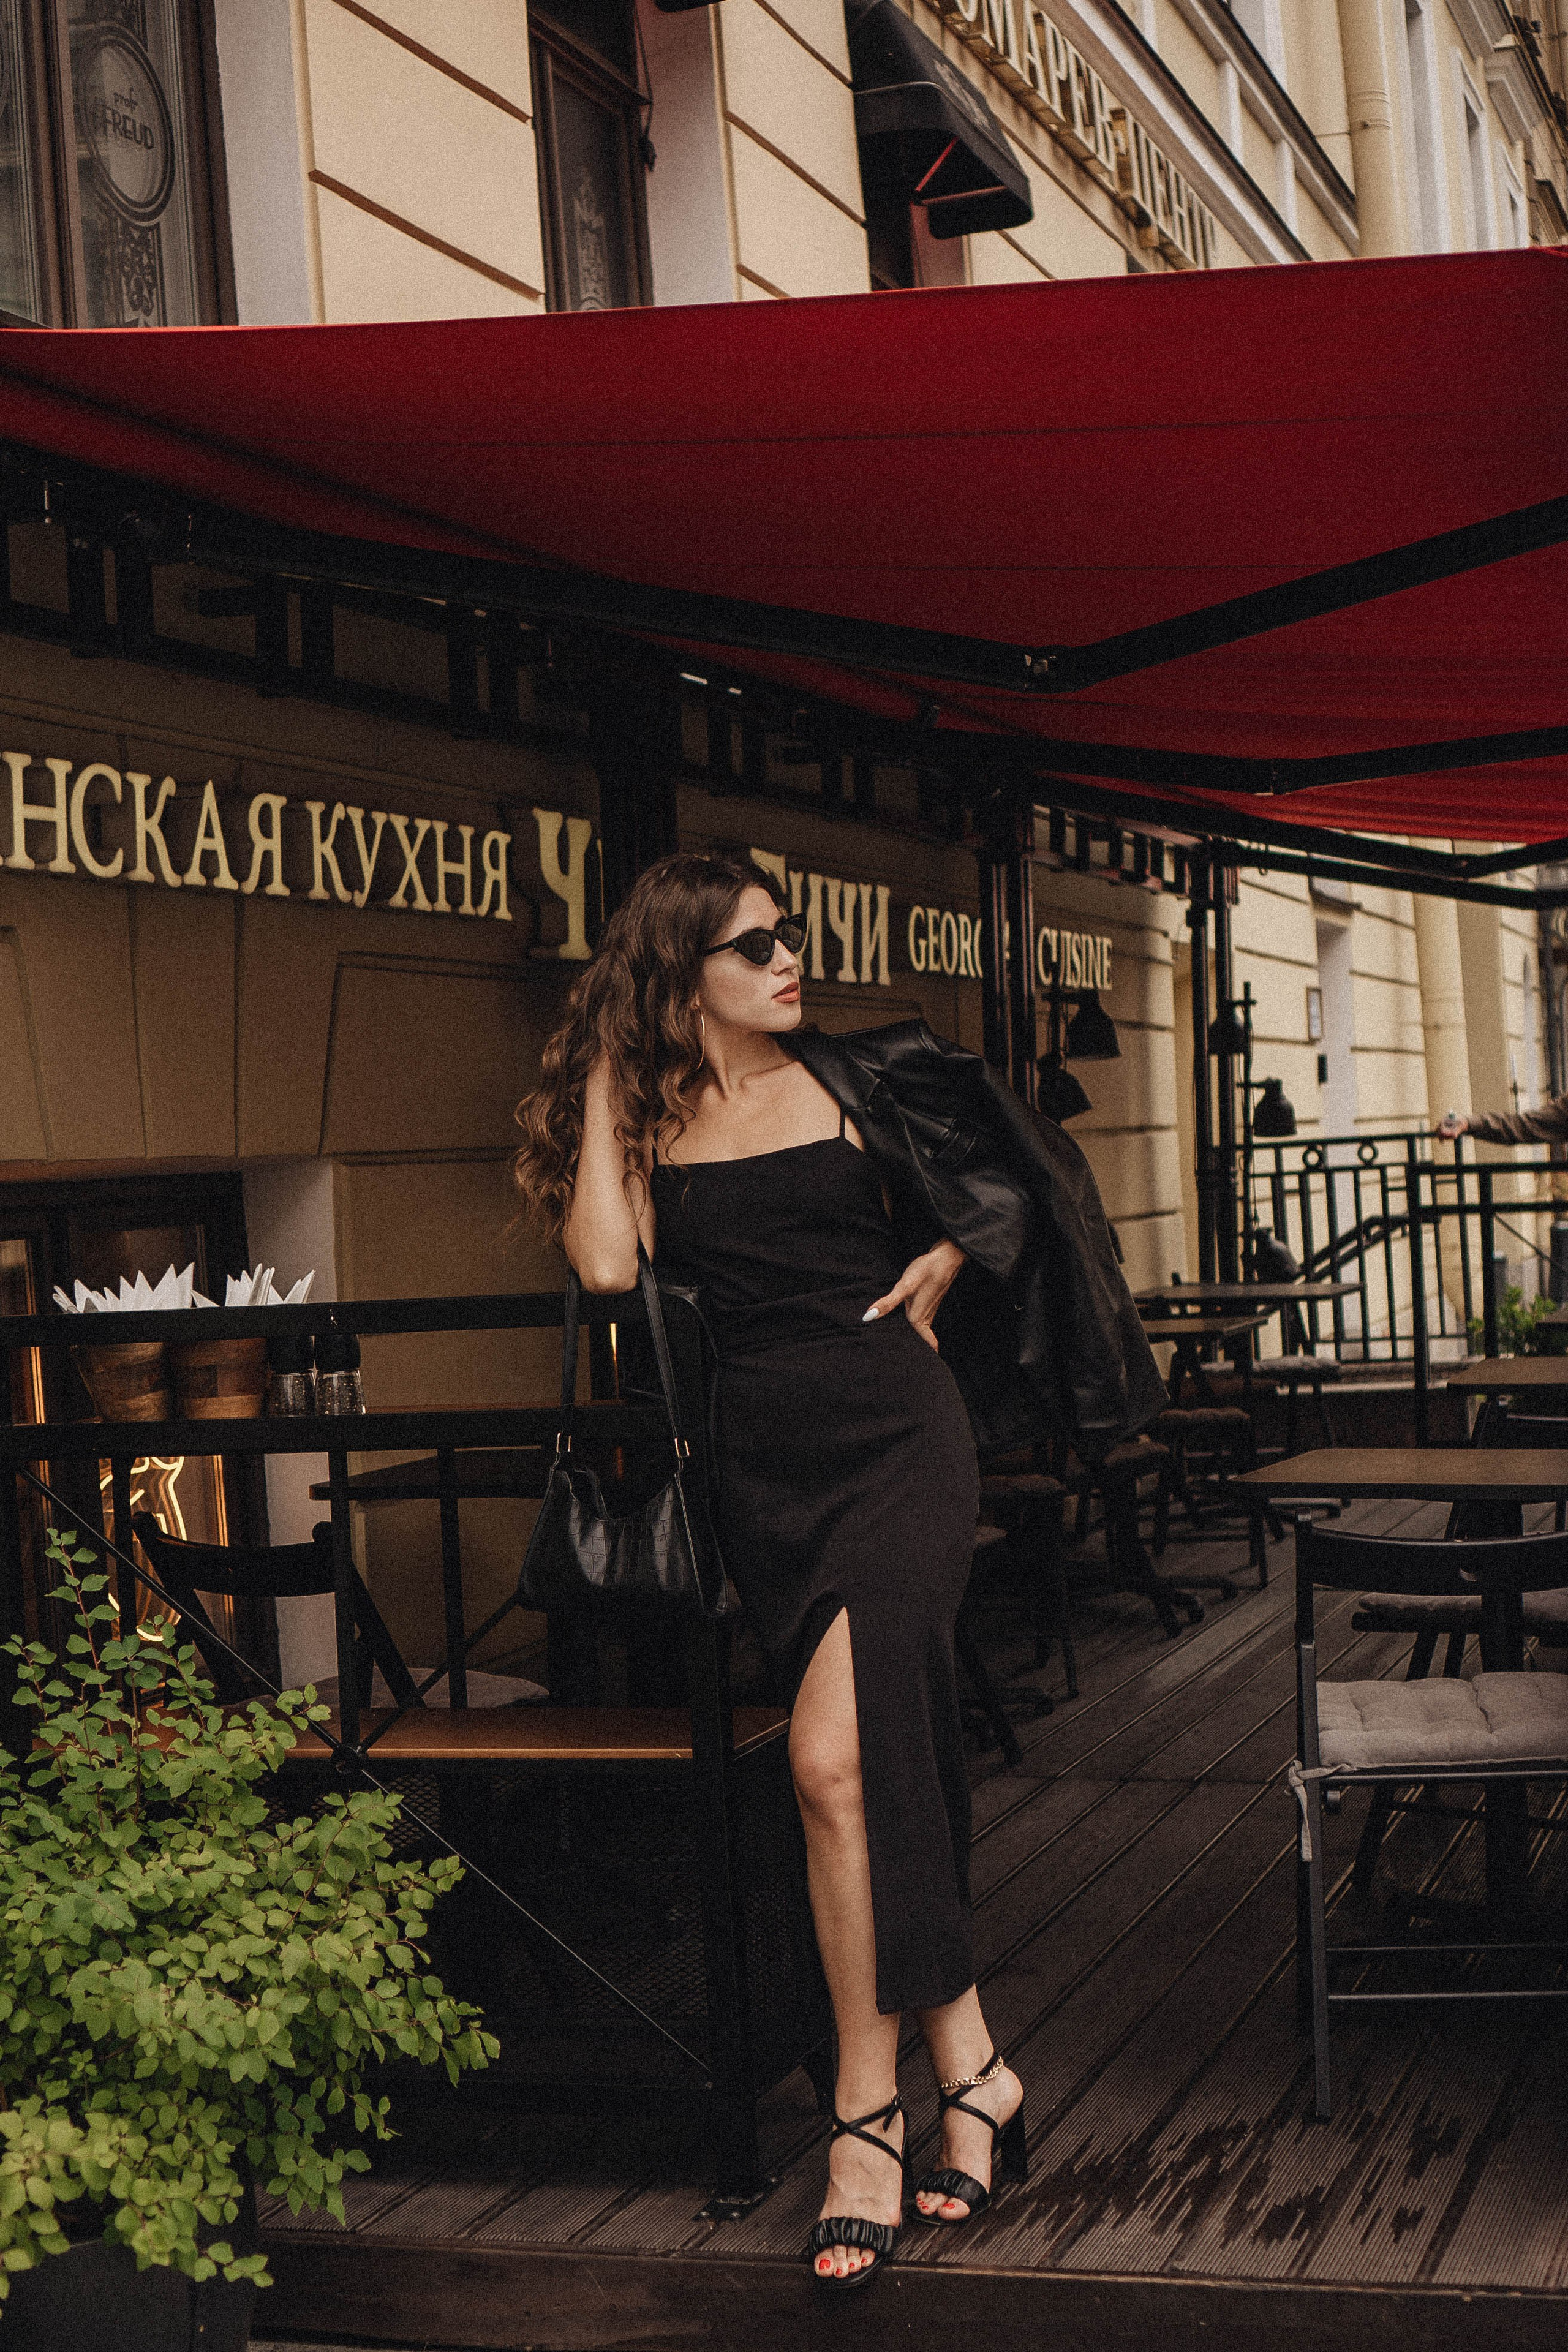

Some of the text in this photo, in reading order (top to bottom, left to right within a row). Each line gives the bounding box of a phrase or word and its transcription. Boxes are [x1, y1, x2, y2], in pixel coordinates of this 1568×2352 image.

[102, 104, 156, 151] FREUD
[0, 751, 513, 921] НСКАЯ КУХНЯ
[750, 846, 891, 987] ИЧИ
[1036, 925, 1113, 990] CUISINE
